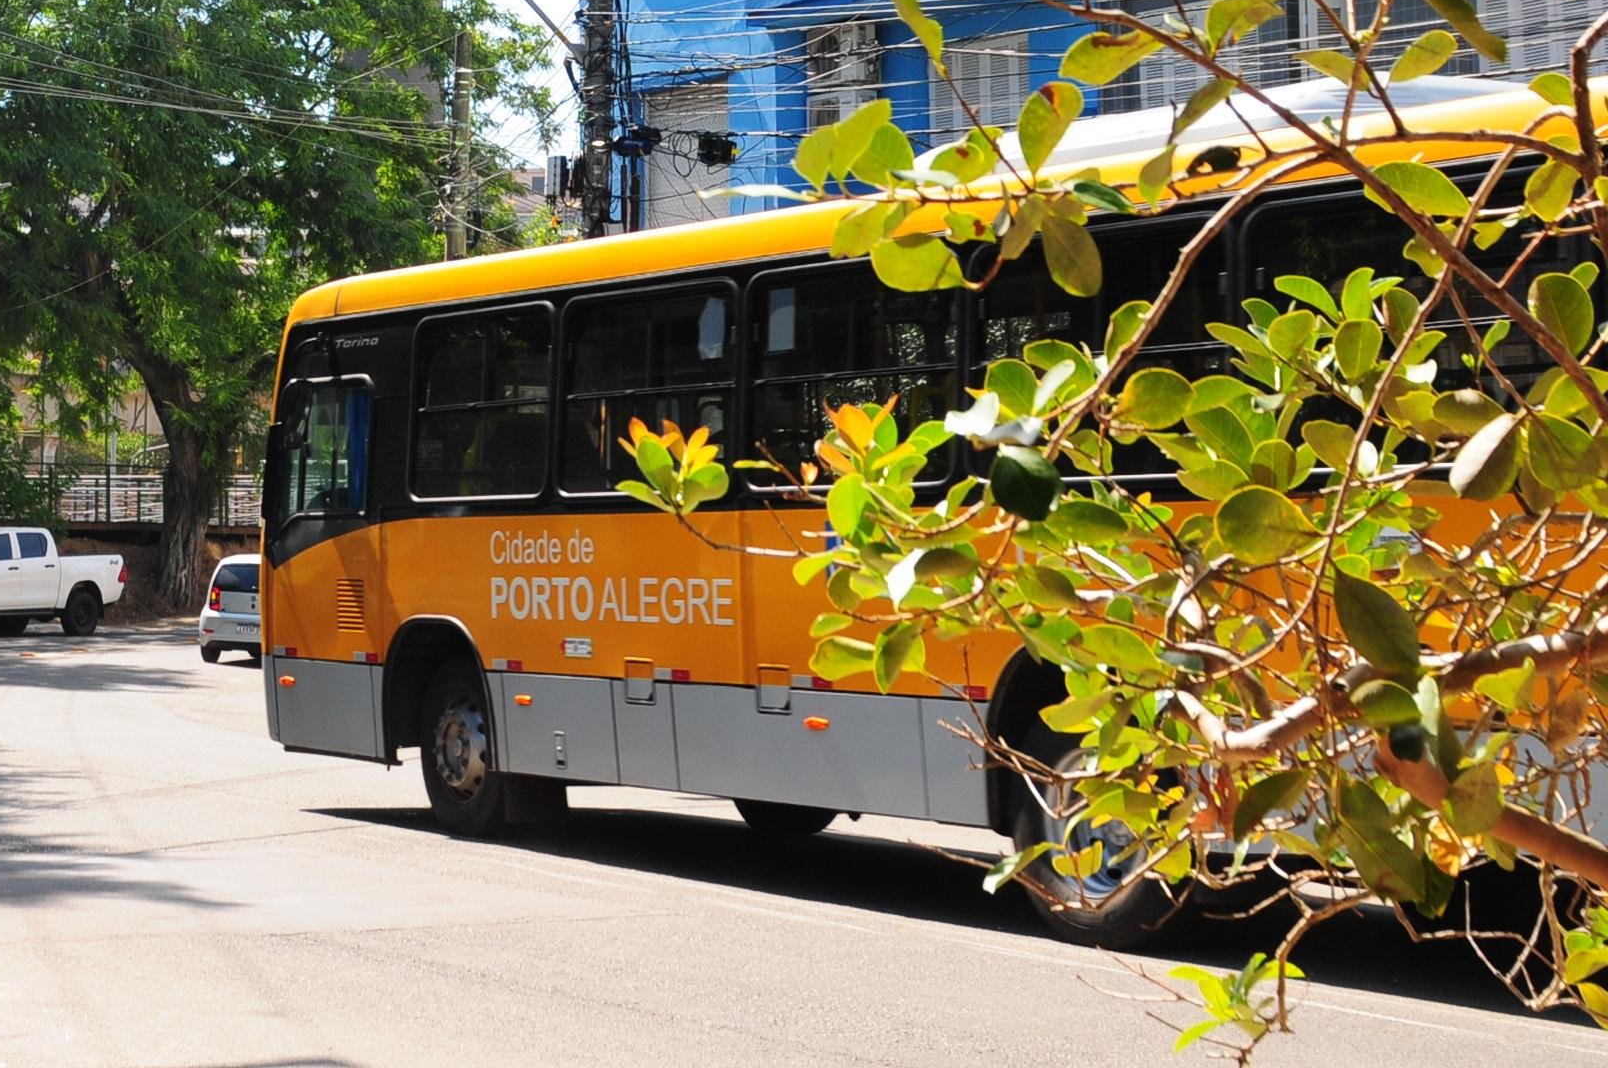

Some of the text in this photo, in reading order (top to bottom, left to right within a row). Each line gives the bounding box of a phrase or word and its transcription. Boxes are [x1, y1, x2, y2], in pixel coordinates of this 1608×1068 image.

[334, 336, 379, 349] Torino
[489, 529, 594, 565] Cidade de
[490, 576, 734, 626] PORTO ALEGRE
